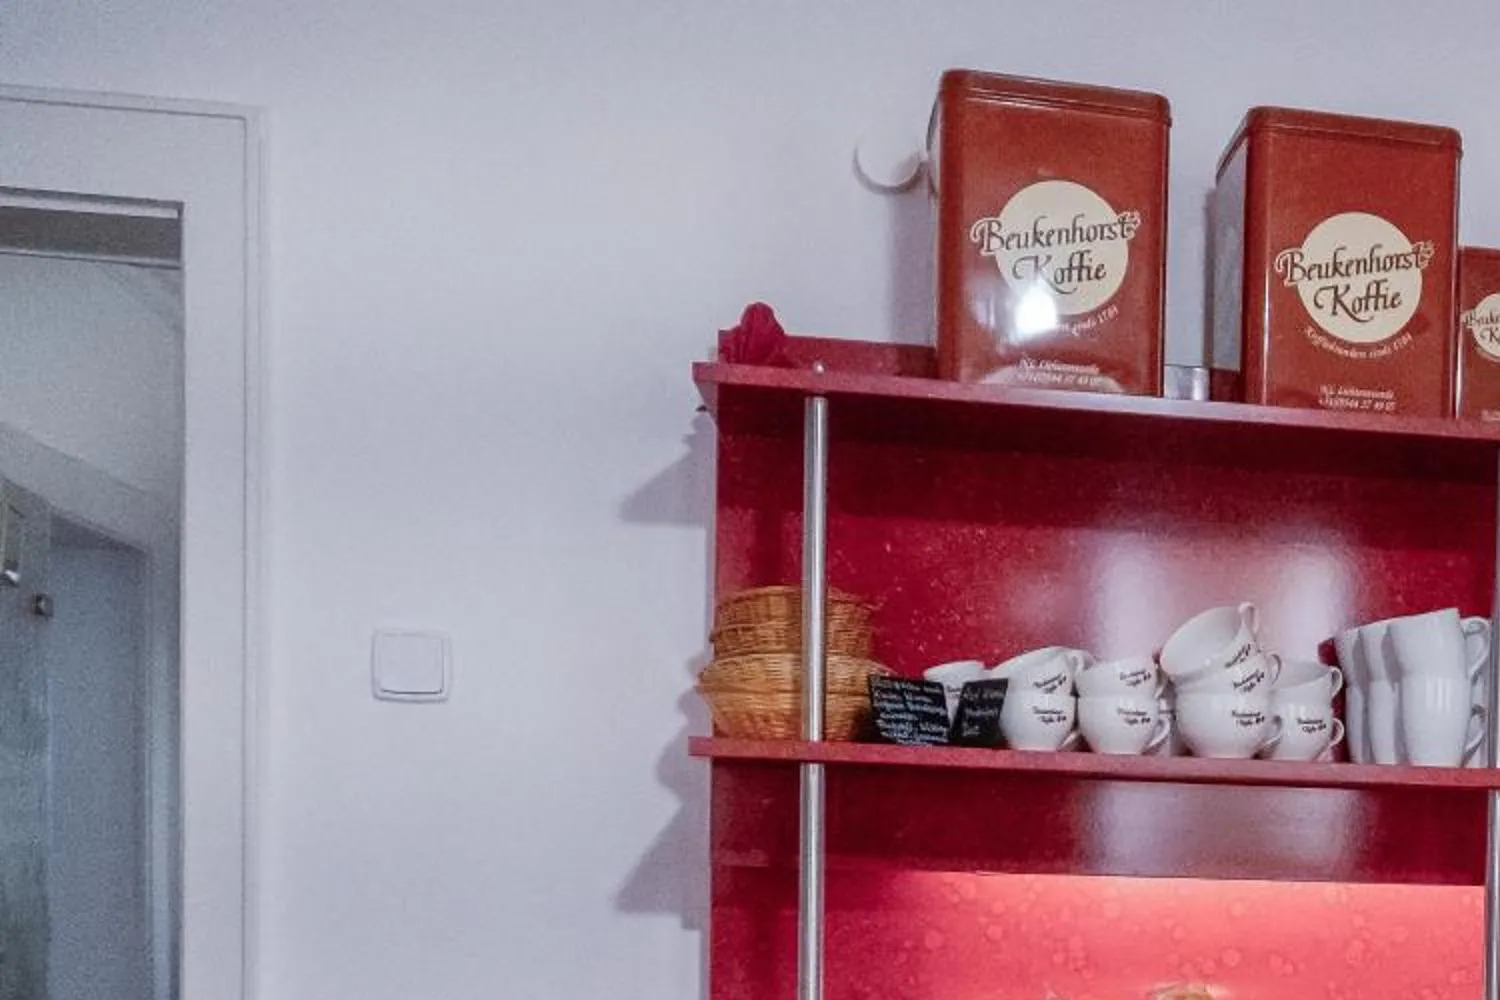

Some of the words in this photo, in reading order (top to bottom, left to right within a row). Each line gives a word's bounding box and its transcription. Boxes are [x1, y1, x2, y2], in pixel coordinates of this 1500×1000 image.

[972, 211, 1141, 254] Beukenhorst
[1012, 249, 1107, 295] Koffie
[1275, 241, 1435, 285] Beukenhorst
[1313, 278, 1404, 324] Koffie
